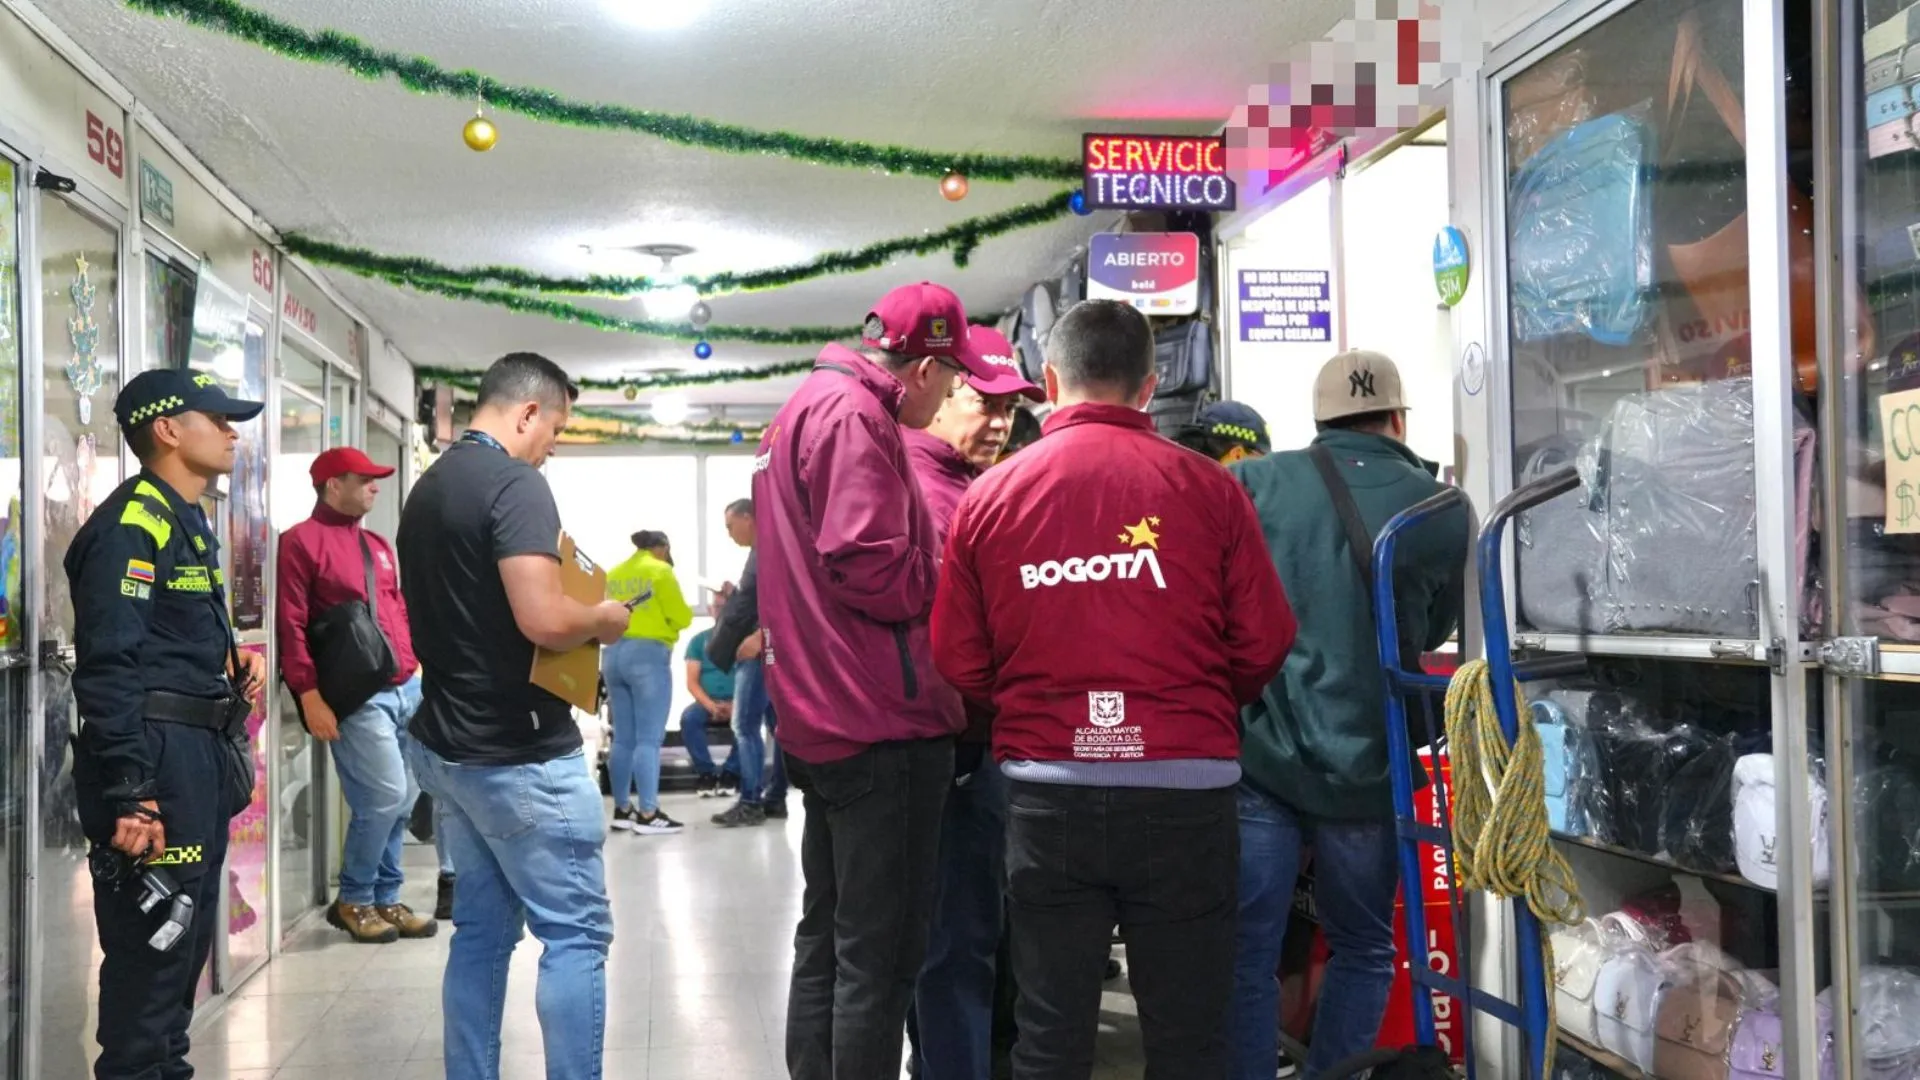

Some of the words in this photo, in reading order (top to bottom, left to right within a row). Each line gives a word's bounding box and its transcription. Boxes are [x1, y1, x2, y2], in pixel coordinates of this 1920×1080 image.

[86, 109, 123, 179] 59
[1091, 173, 1228, 204] TECNICO
[252, 249, 273, 295] 60
[1104, 252, 1185, 266] ABIERTO
[284, 293, 316, 333] AVISO
[1113, 726, 1142, 734] MAYOR
